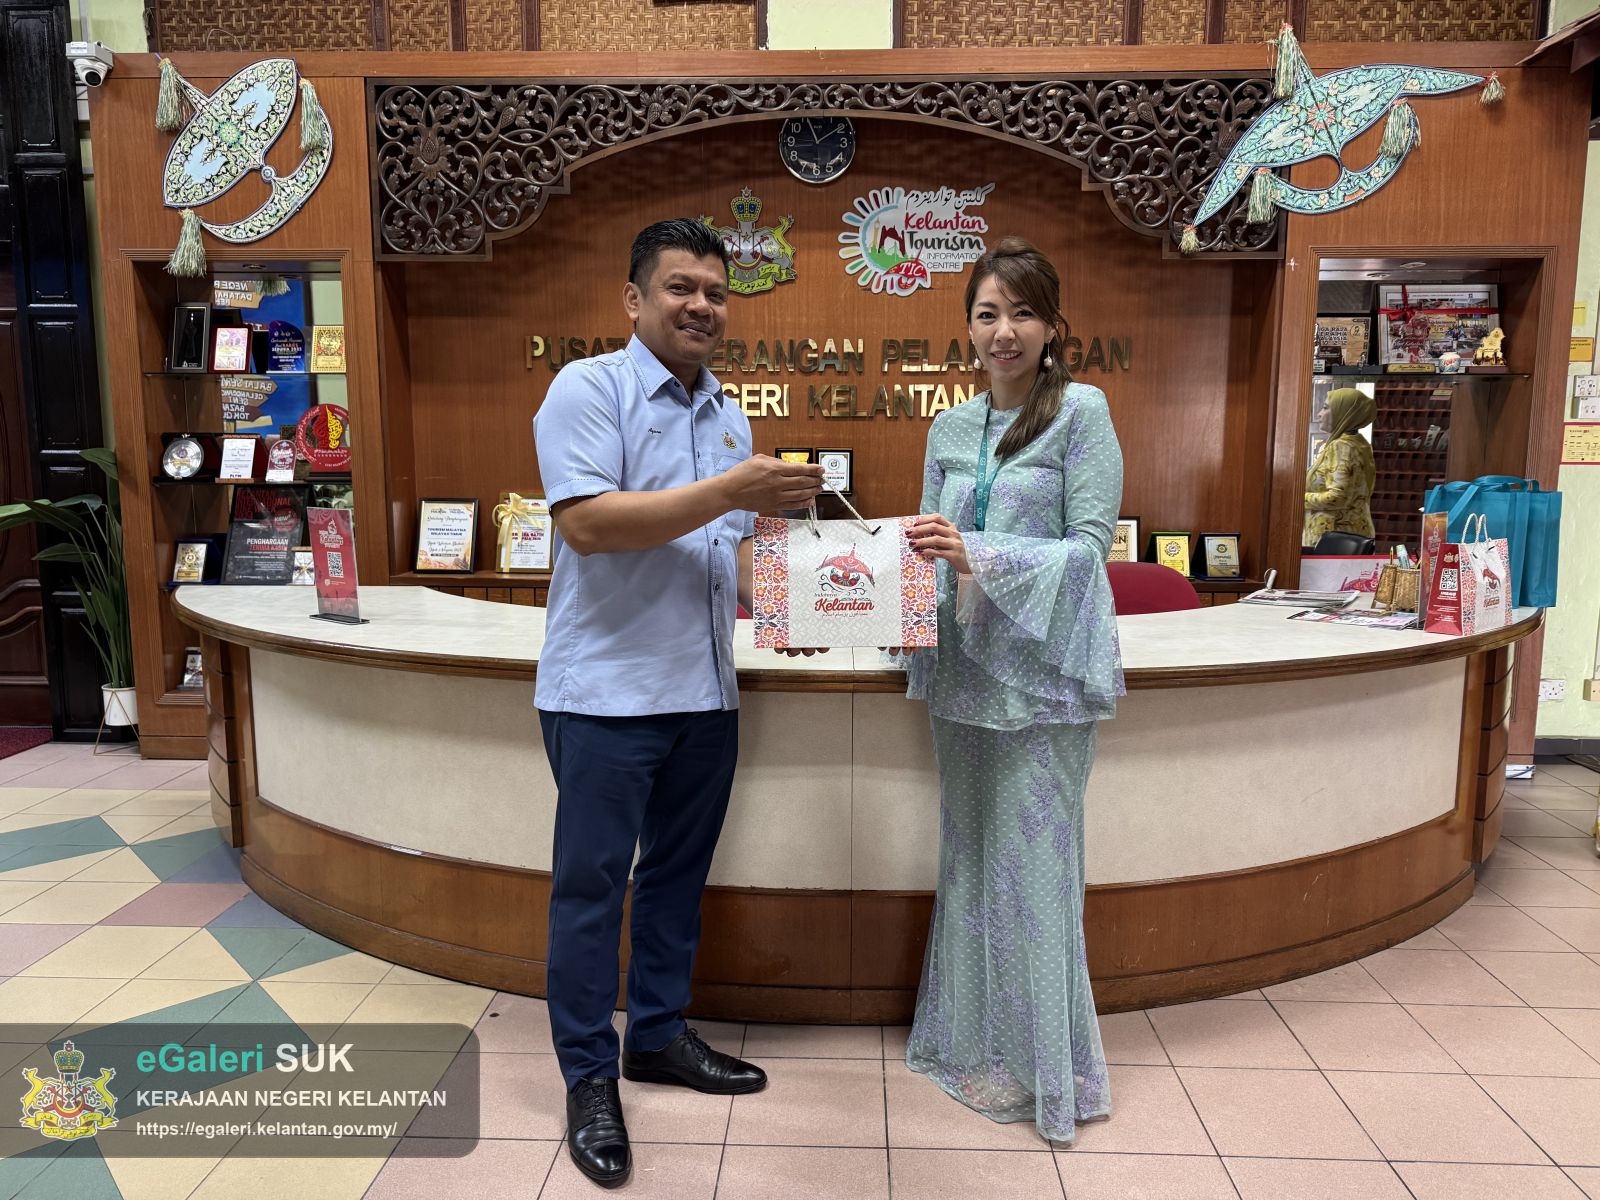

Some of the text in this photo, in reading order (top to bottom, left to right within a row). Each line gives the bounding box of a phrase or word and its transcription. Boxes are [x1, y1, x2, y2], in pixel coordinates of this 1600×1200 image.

[791, 122, 802, 133] 10
[787, 136, 796, 147] 9
[840, 137, 848, 148] 3
[790, 150, 798, 161] 8
[836, 151, 844, 162] 4
[812, 163, 820, 176] 6
[825, 162, 833, 173] 5
[904, 210, 985, 231] Kelantan
[906, 231, 984, 251] Tourism
[900, 262, 924, 276] TIC
[926, 261, 960, 270] CENTRE
[708, 337, 865, 374] ERANGAN
[721, 382, 975, 418] GERI KELANTAN
[814, 597, 875, 614] Kelantan
